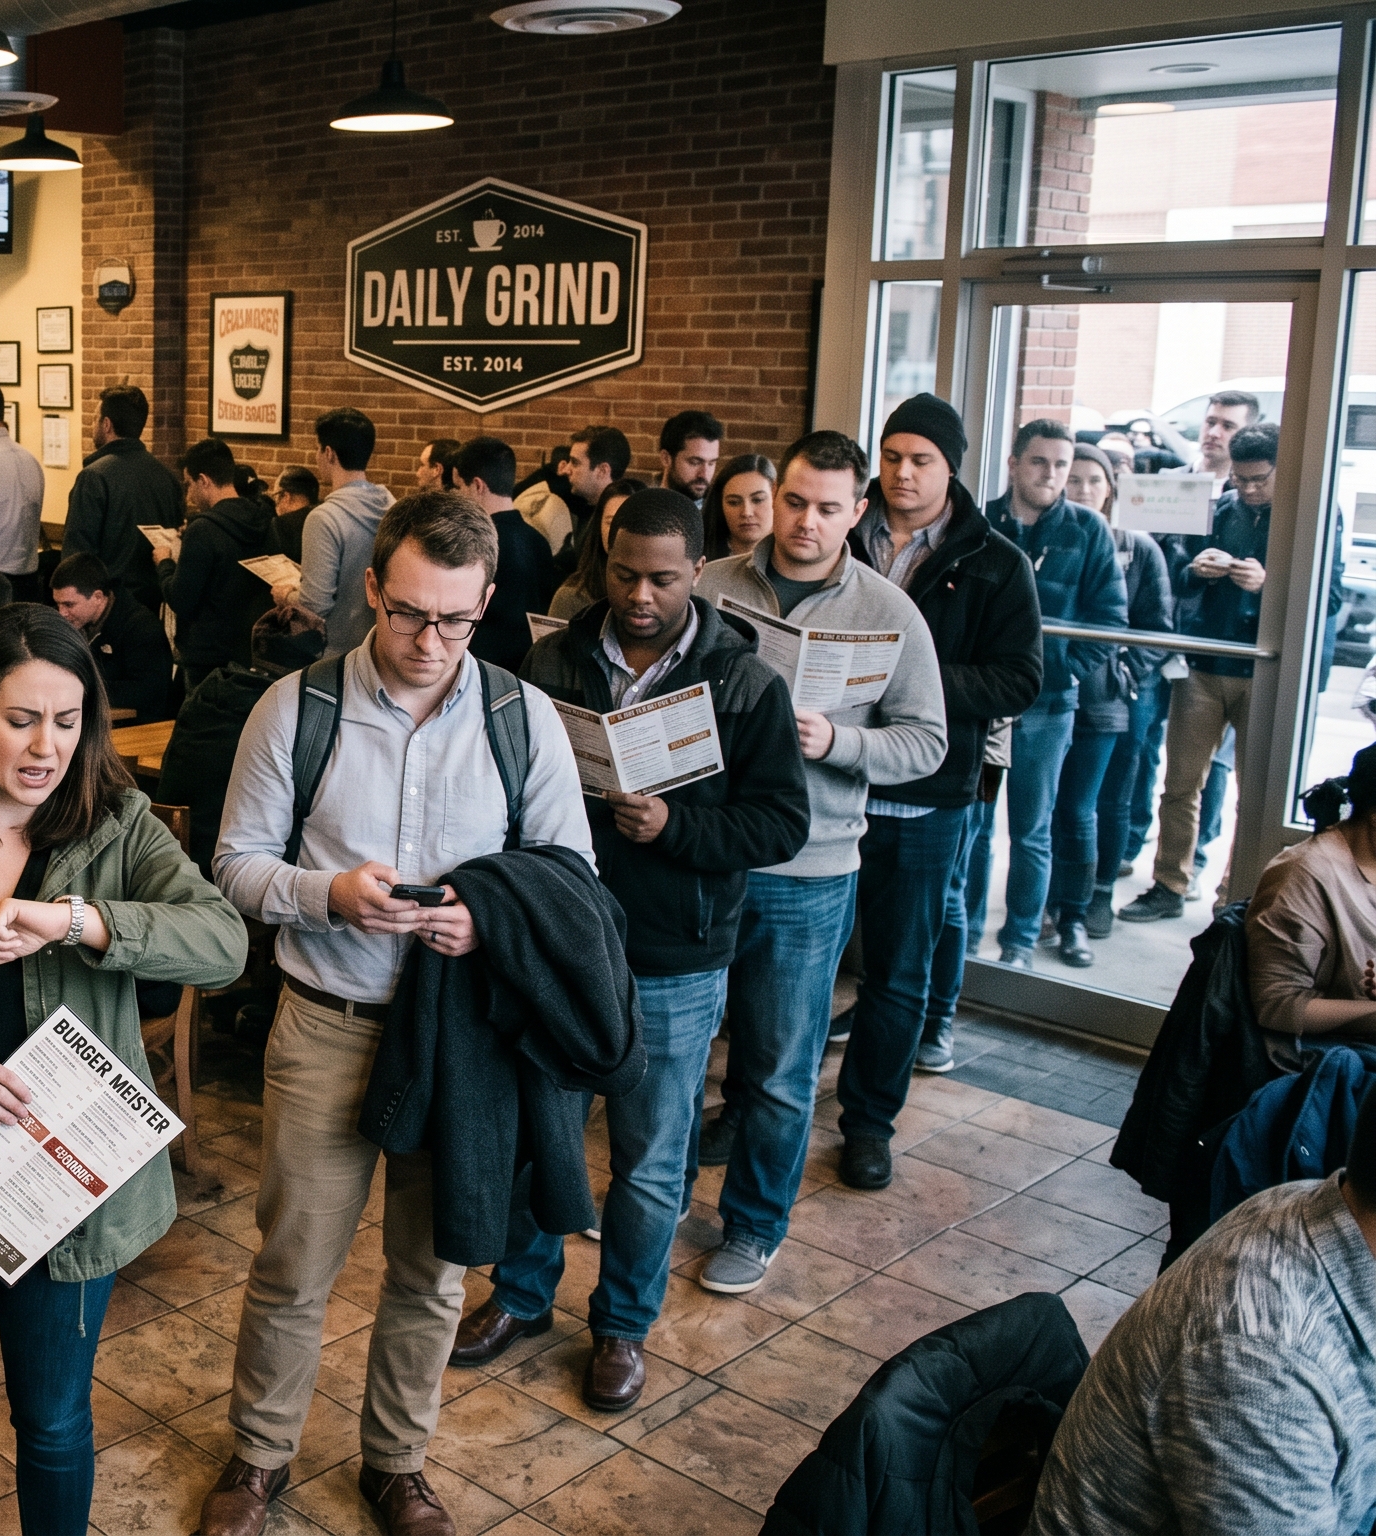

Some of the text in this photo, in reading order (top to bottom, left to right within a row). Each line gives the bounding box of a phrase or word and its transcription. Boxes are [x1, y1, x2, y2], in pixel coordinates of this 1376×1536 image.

[435, 224, 545, 243] EST. 2014
[362, 261, 620, 328] DAILY GRIND
[442, 356, 523, 373] EST. 2014
[52, 1017, 113, 1079] BURGER
[109, 1073, 171, 1135] MEISTER
